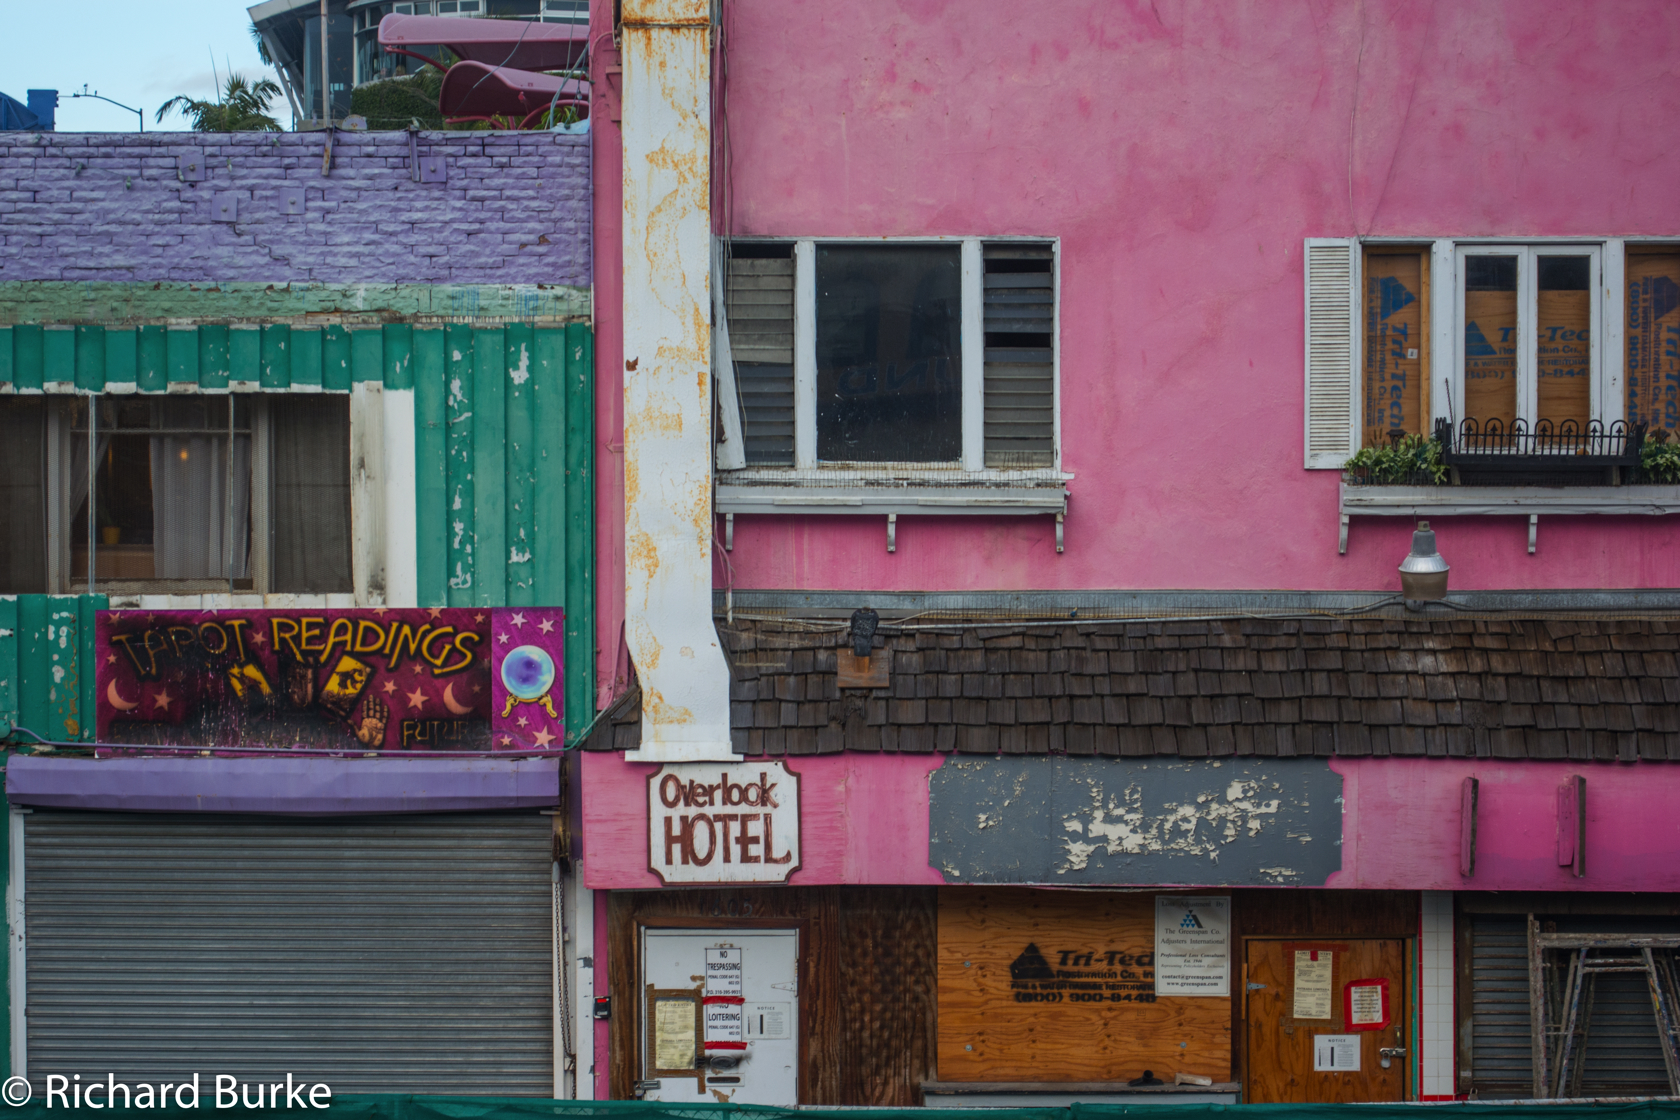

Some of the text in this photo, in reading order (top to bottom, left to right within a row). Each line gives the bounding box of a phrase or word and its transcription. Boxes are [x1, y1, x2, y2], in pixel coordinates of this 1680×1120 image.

[1390, 322, 1408, 429] Tri-Tech
[111, 616, 481, 676] TAROT READINGS
[403, 721, 484, 747] FUTUR
[659, 771, 780, 809] Overlook
[663, 812, 792, 867] HOTEL
[1180, 901, 1212, 909] Adjustment
[1178, 928, 1208, 936] Greenspan
[719, 950, 728, 958] NO
[707, 962, 741, 971] TRESPASSING
[1015, 992, 1157, 1003] (800) 900-8448
[708, 1013, 741, 1021] LOITERING
